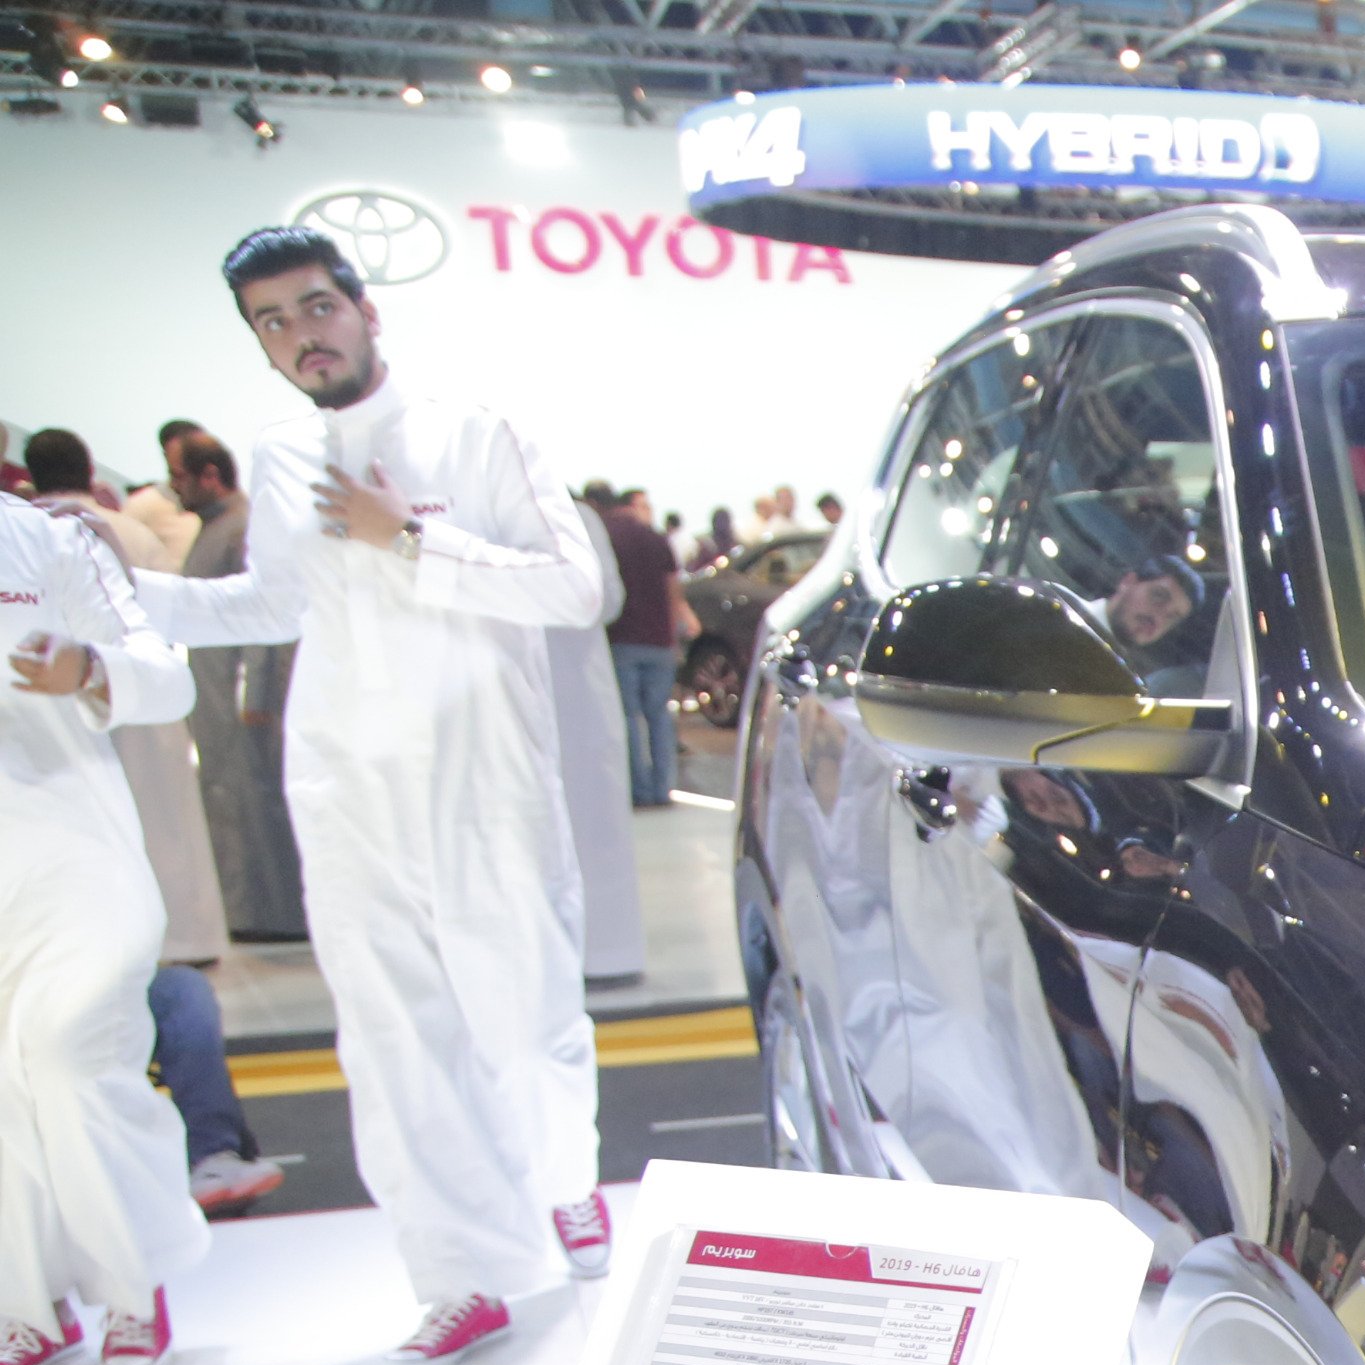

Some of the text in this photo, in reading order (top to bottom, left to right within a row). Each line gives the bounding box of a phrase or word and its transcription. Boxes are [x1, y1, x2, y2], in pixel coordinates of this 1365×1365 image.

[926, 110, 1261, 179] HYBRID
[701, 1244, 755, 1259] سوبريم
[878, 1257, 912, 1271] 2019
[922, 1262, 941, 1274] H6
[942, 1264, 981, 1277] هافال
